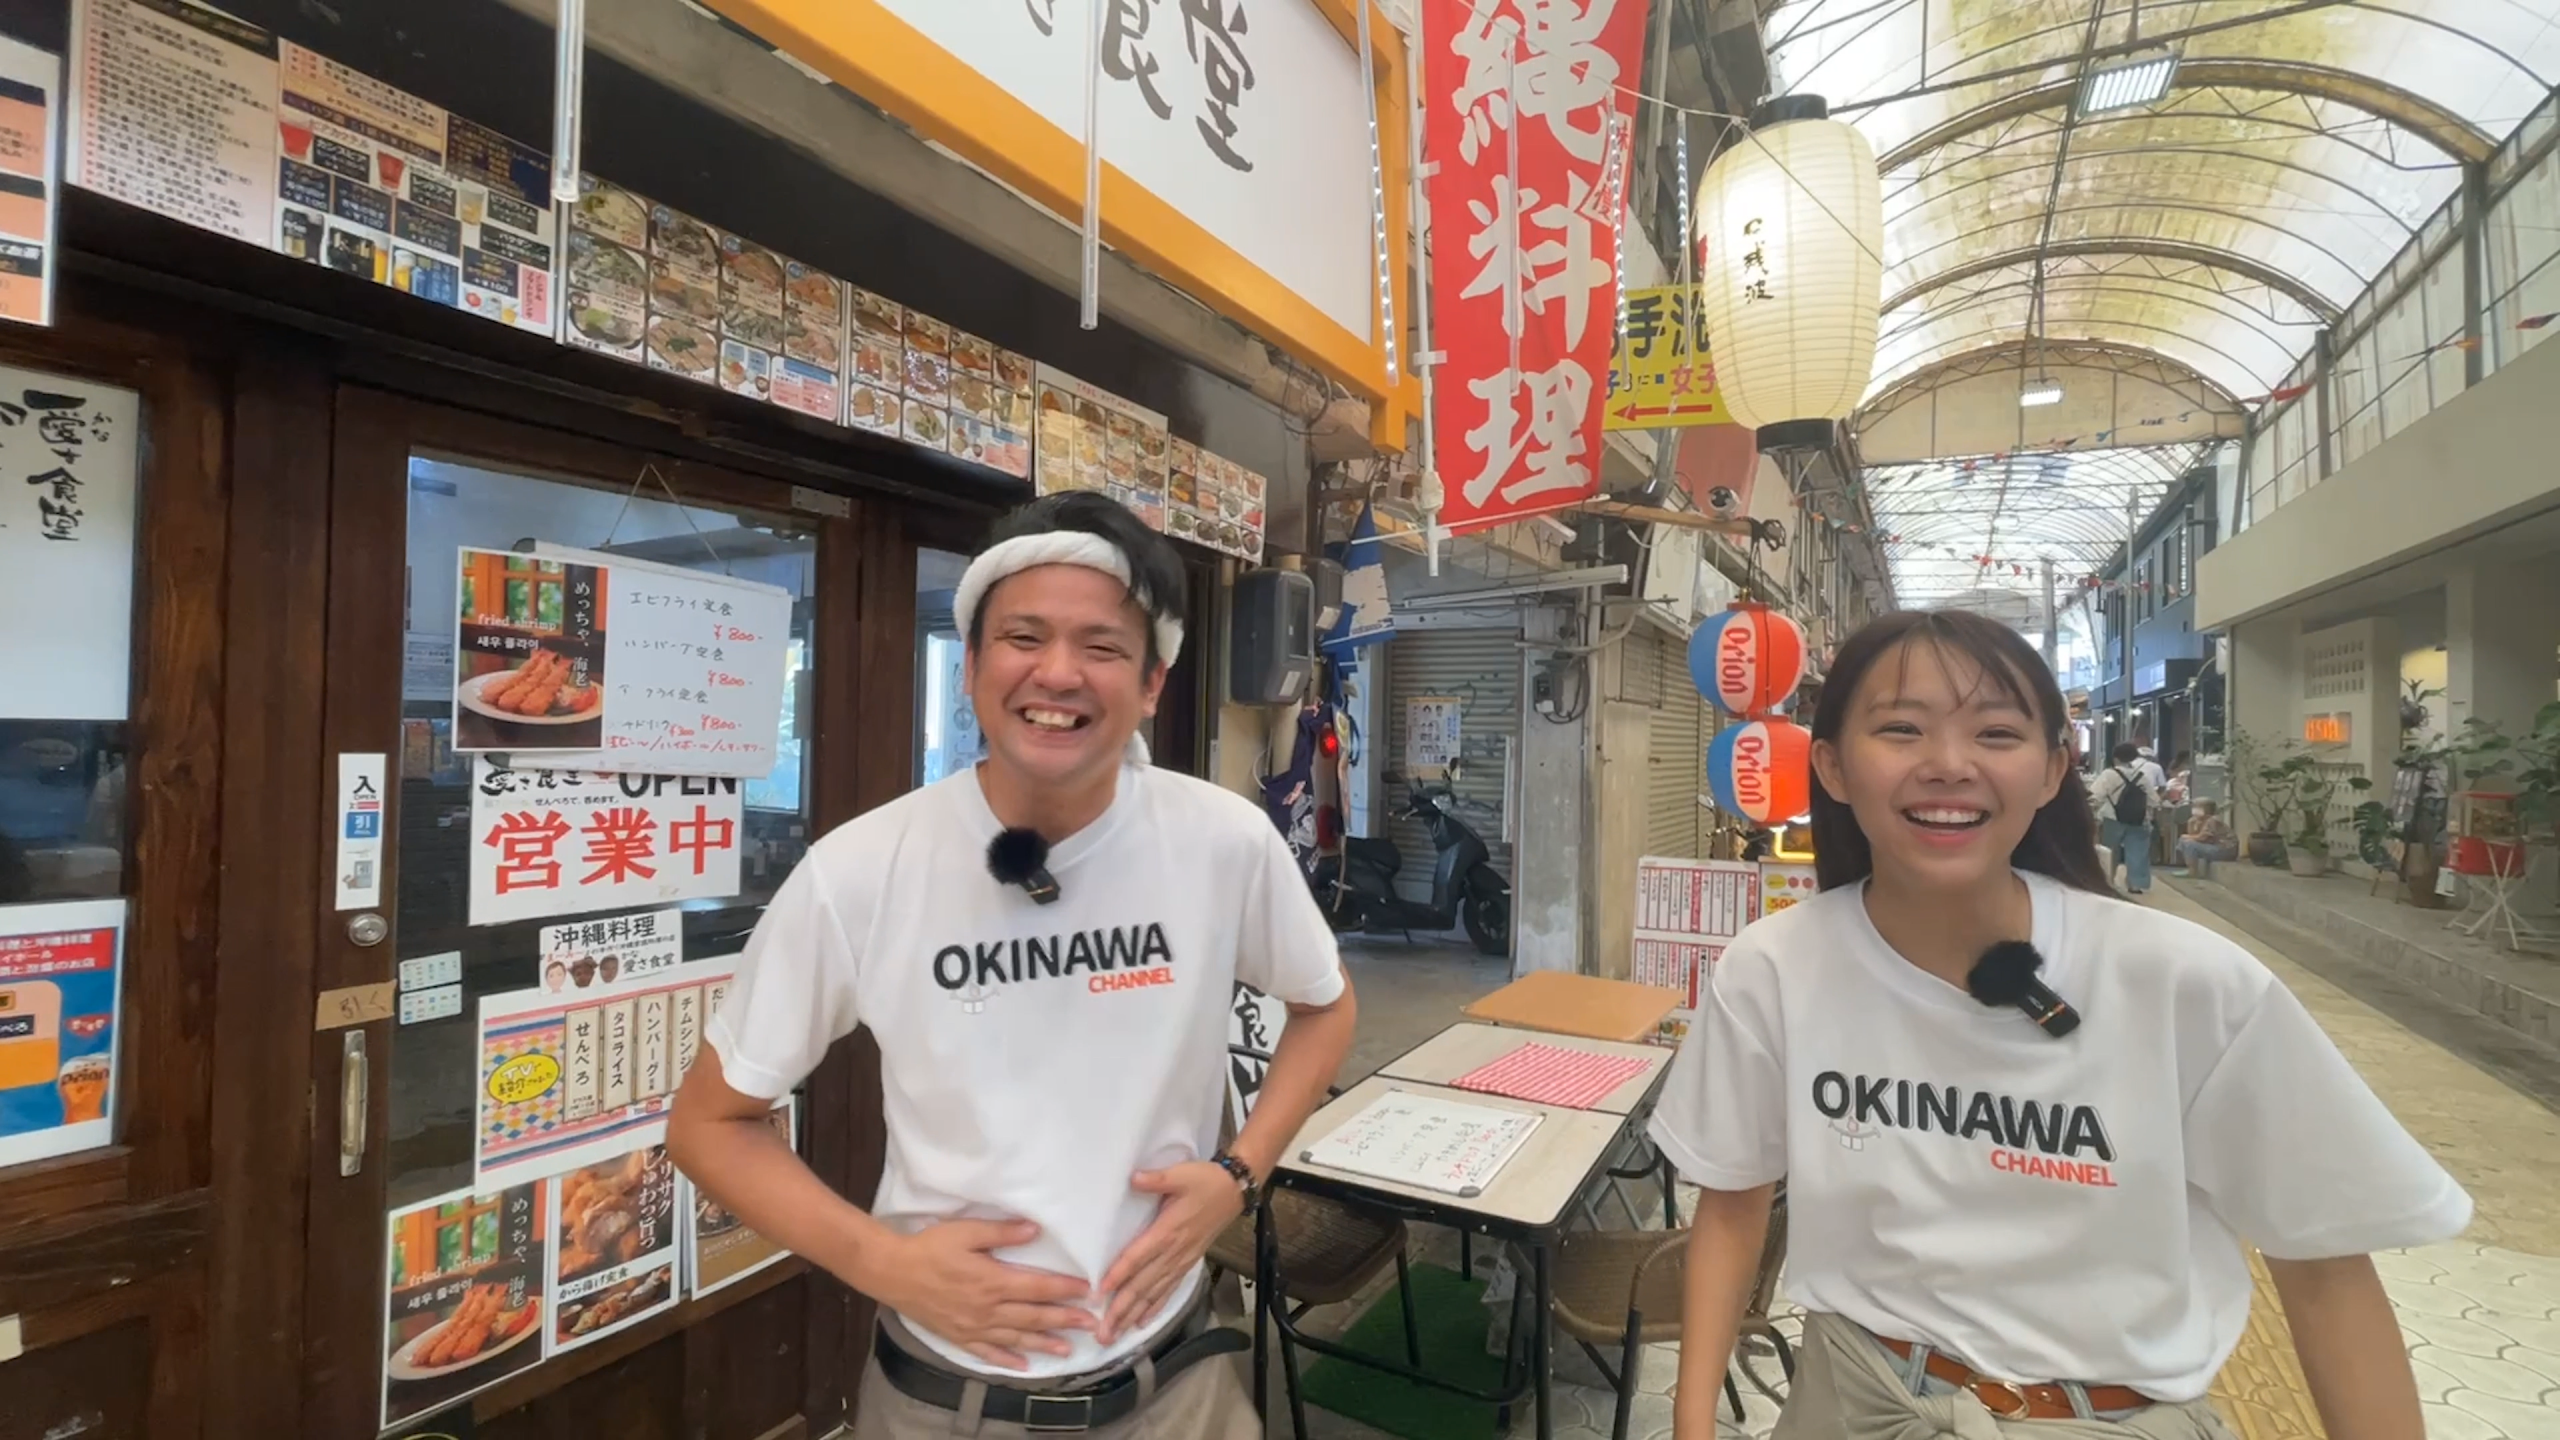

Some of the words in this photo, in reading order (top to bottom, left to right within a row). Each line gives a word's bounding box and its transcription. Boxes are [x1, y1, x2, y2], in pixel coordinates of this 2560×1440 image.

[476, 635, 502, 649] 새우
[477, 612, 511, 627] fried
[514, 617, 557, 632] shrimp
[1721, 626, 1756, 695] Orion
[352, 775, 377, 795] 入
[1736, 735, 1773, 806] Orion
[354, 815, 371, 830] 引
[483, 804, 734, 896] 営業中
[933, 921, 1175, 990] OKINAWA
[1087, 967, 1176, 994] CHANNEL
[575, 1022, 591, 1087] せんべろ
[610, 1012, 628, 1088] タコライス
[646, 1000, 662, 1078] ハンバーグ
[1812, 1070, 2118, 1163] OKINAWA
[1990, 1149, 2119, 1188] CHANNEL
[406, 1293, 433, 1310] 새우
[409, 1266, 442, 1286] fried
